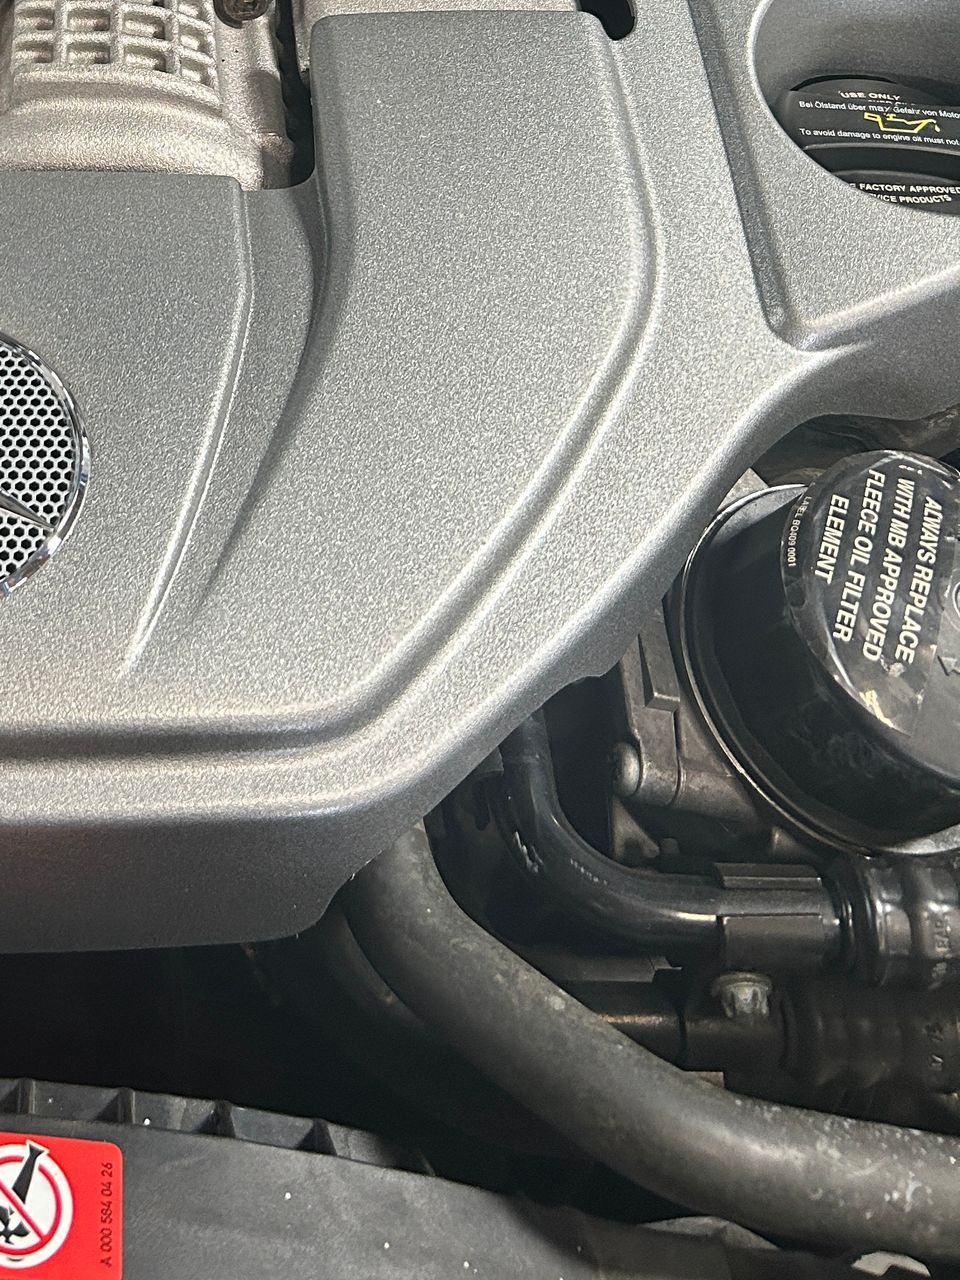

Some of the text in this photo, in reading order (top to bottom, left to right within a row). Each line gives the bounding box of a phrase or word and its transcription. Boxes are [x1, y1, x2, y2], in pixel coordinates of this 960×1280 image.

[840, 91, 901, 100] USE ONLY
[847, 103, 866, 111] über
[893, 106, 921, 115] Gefahr
[813, 129, 836, 137] avoid
[837, 130, 871, 139] damage
[882, 133, 910, 142] engine
[924, 137, 945, 145] must
[945, 138, 960, 146] not
[859, 183, 906, 192] FACTORY
[909, 185, 960, 194] APPROVED
[898, 195, 952, 204] PRODUCTS
[794, 496, 812, 520] LABEL
[814, 494, 850, 585] ELEMENT
[787, 546, 797, 567] 0001
[833, 469, 886, 642] FLEECE OIL FILTER
[862, 478, 915, 662] WITH MB APPROVED
[895, 496, 943, 665] ALWAYS REPLACE
[100, 1162, 112, 1268] A 000 584 04 26
